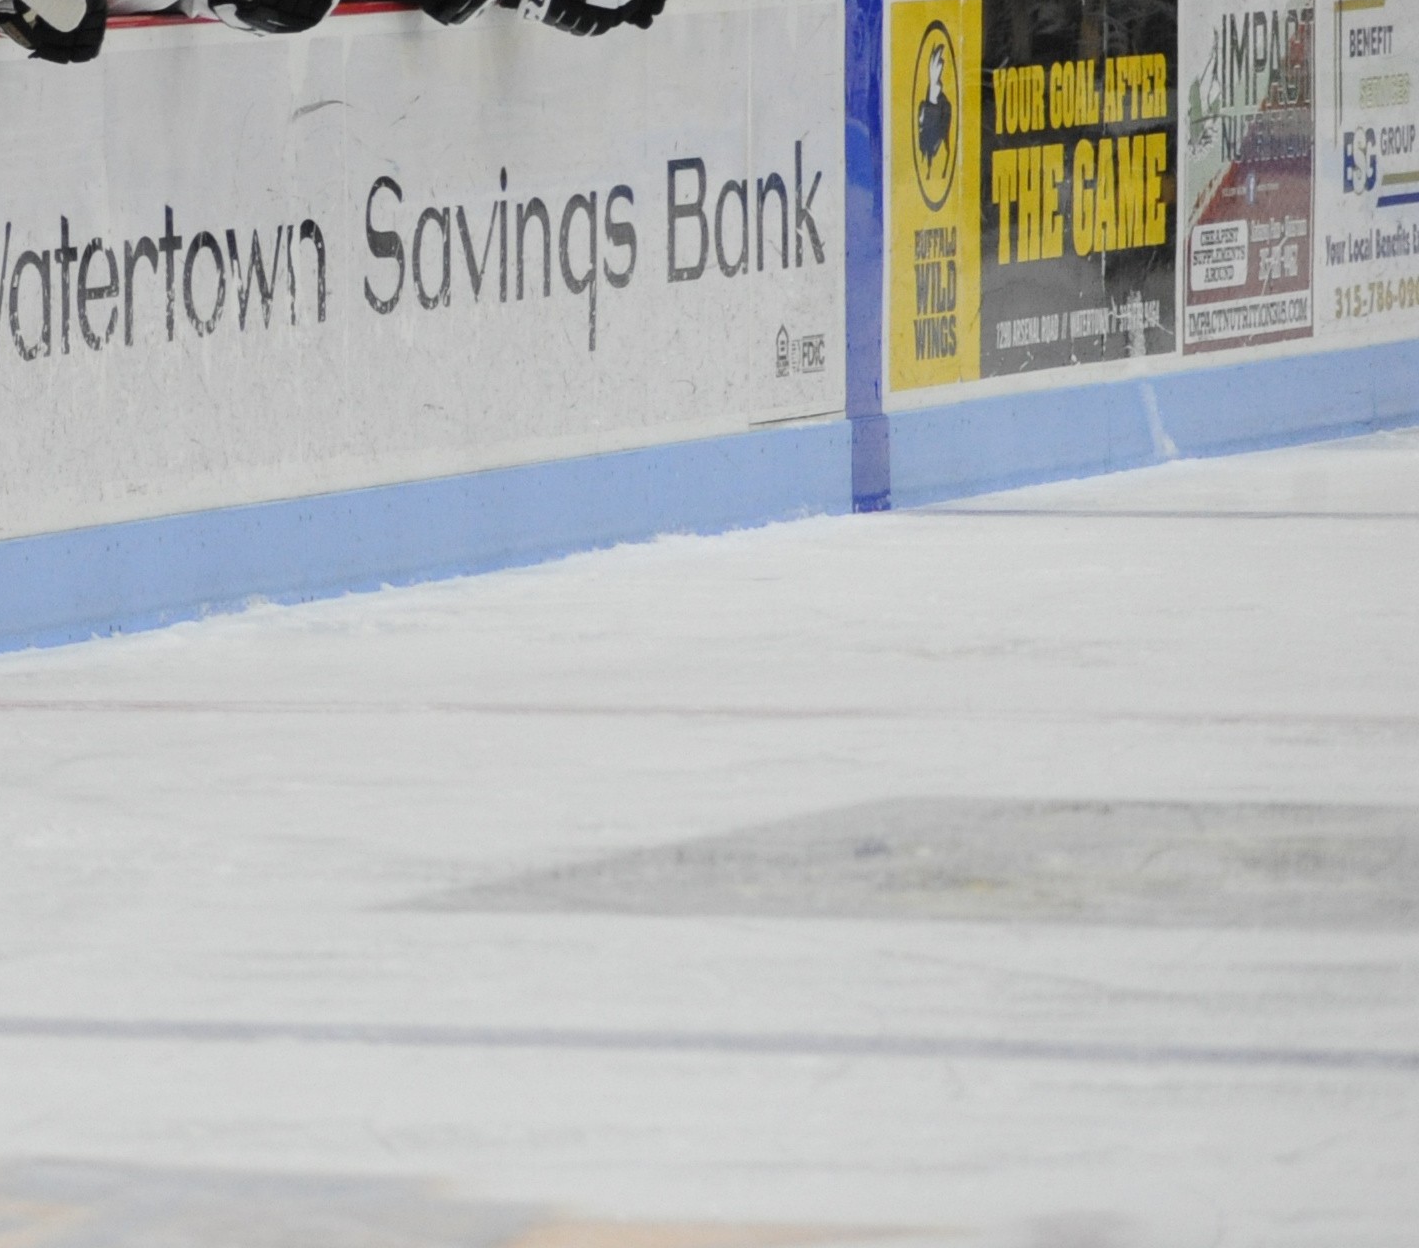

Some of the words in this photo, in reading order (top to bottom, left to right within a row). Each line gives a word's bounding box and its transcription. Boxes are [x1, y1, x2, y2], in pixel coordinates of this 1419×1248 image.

[1222, 8, 1315, 108] IMPACT
[1349, 26, 1393, 58] BENEFIT
[993, 65, 1045, 134] YOUR
[1049, 59, 1100, 129] GOAL
[1103, 54, 1167, 123] AFTER
[1380, 124, 1416, 155] GROUP
[992, 144, 1063, 265] THE
[1072, 133, 1166, 256] GAME
[363, 167, 637, 351] Savings
[666, 141, 825, 285] Bank
[914, 226, 956, 260] BUFFALO
[1326, 235, 1346, 266] Your
[1347, 230, 1373, 263] Local
[1375, 225, 1410, 259] Benefits
[914, 260, 956, 315] WILD
[801, 338, 826, 366] FDIC
[913, 315, 957, 361] WINGS
